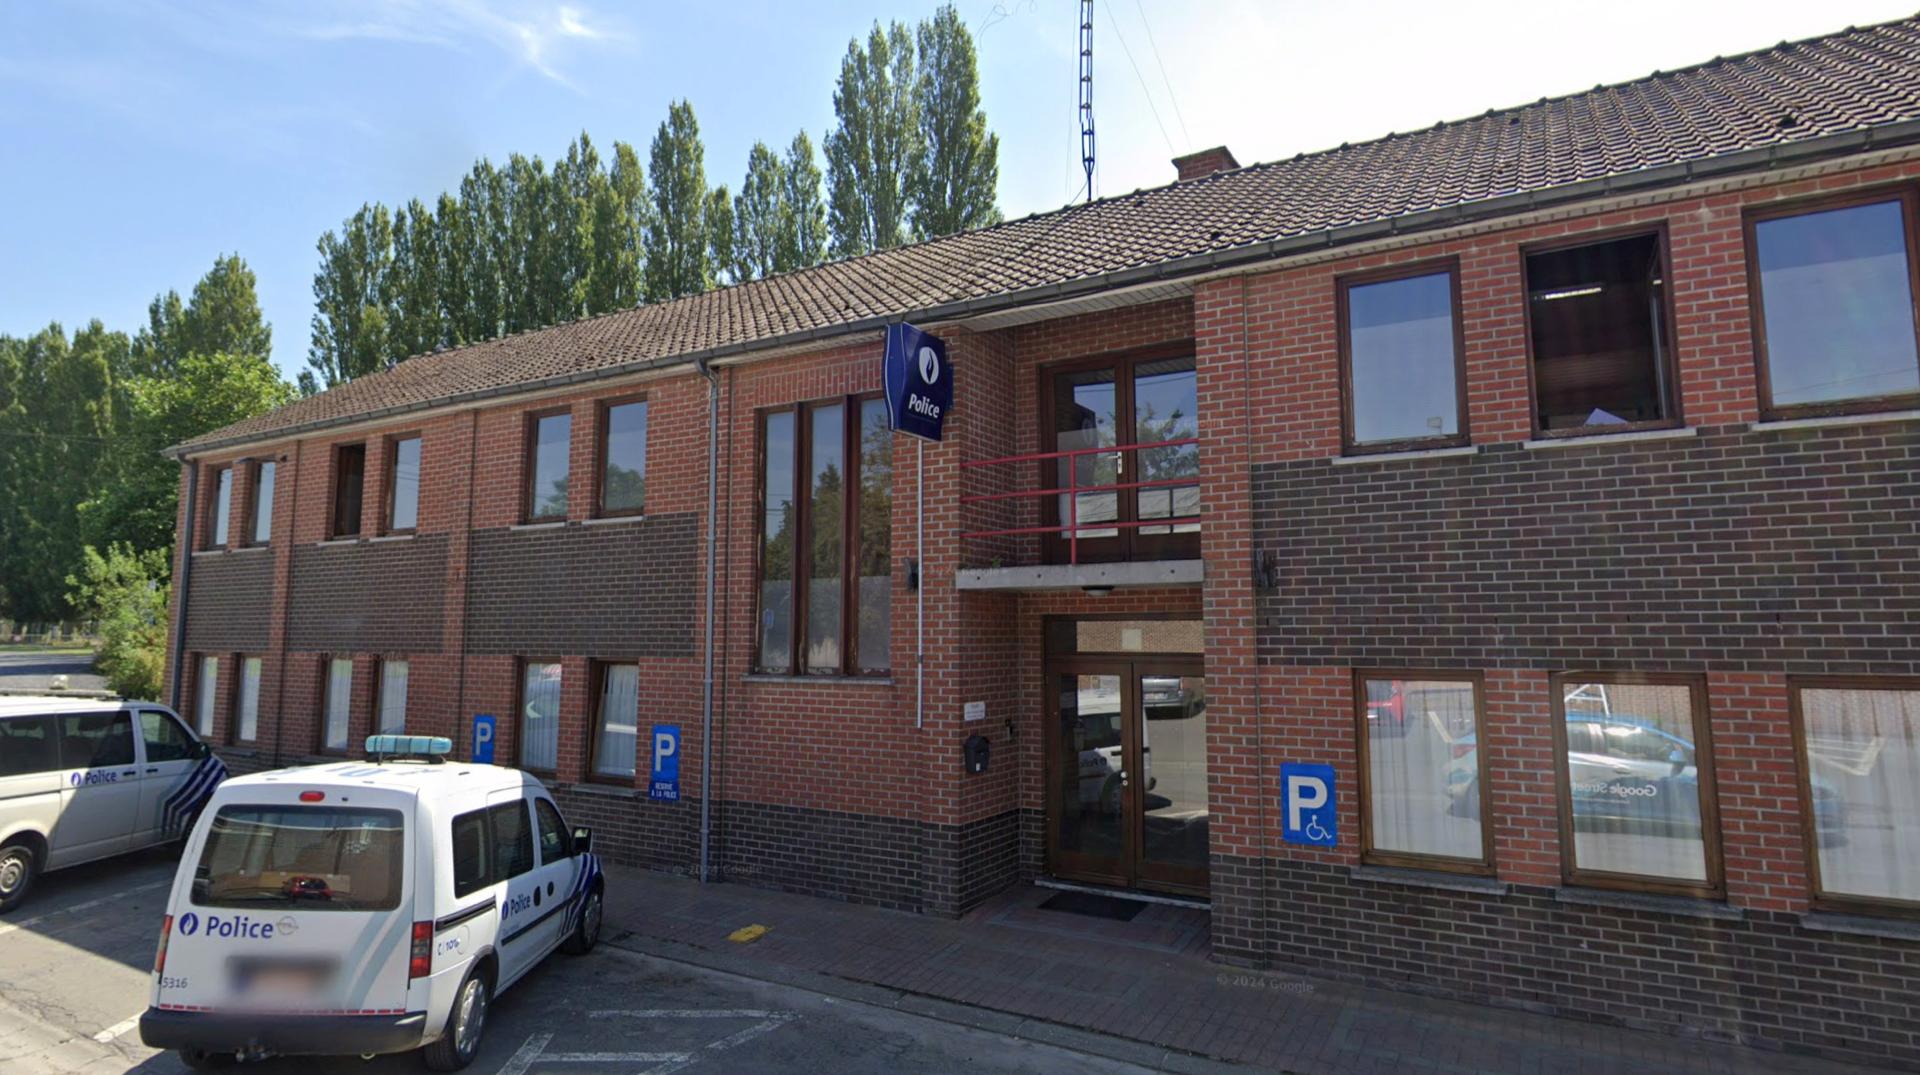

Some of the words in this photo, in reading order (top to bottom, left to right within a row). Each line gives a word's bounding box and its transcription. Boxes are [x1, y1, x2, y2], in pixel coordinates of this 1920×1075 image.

[908, 393, 940, 418] Police
[476, 722, 491, 756] P
[655, 733, 675, 772] P
[85, 769, 117, 785] Police
[1288, 775, 1328, 832] P
[510, 893, 531, 916] Police
[206, 916, 273, 939] Police
[162, 977, 188, 989] 5316
